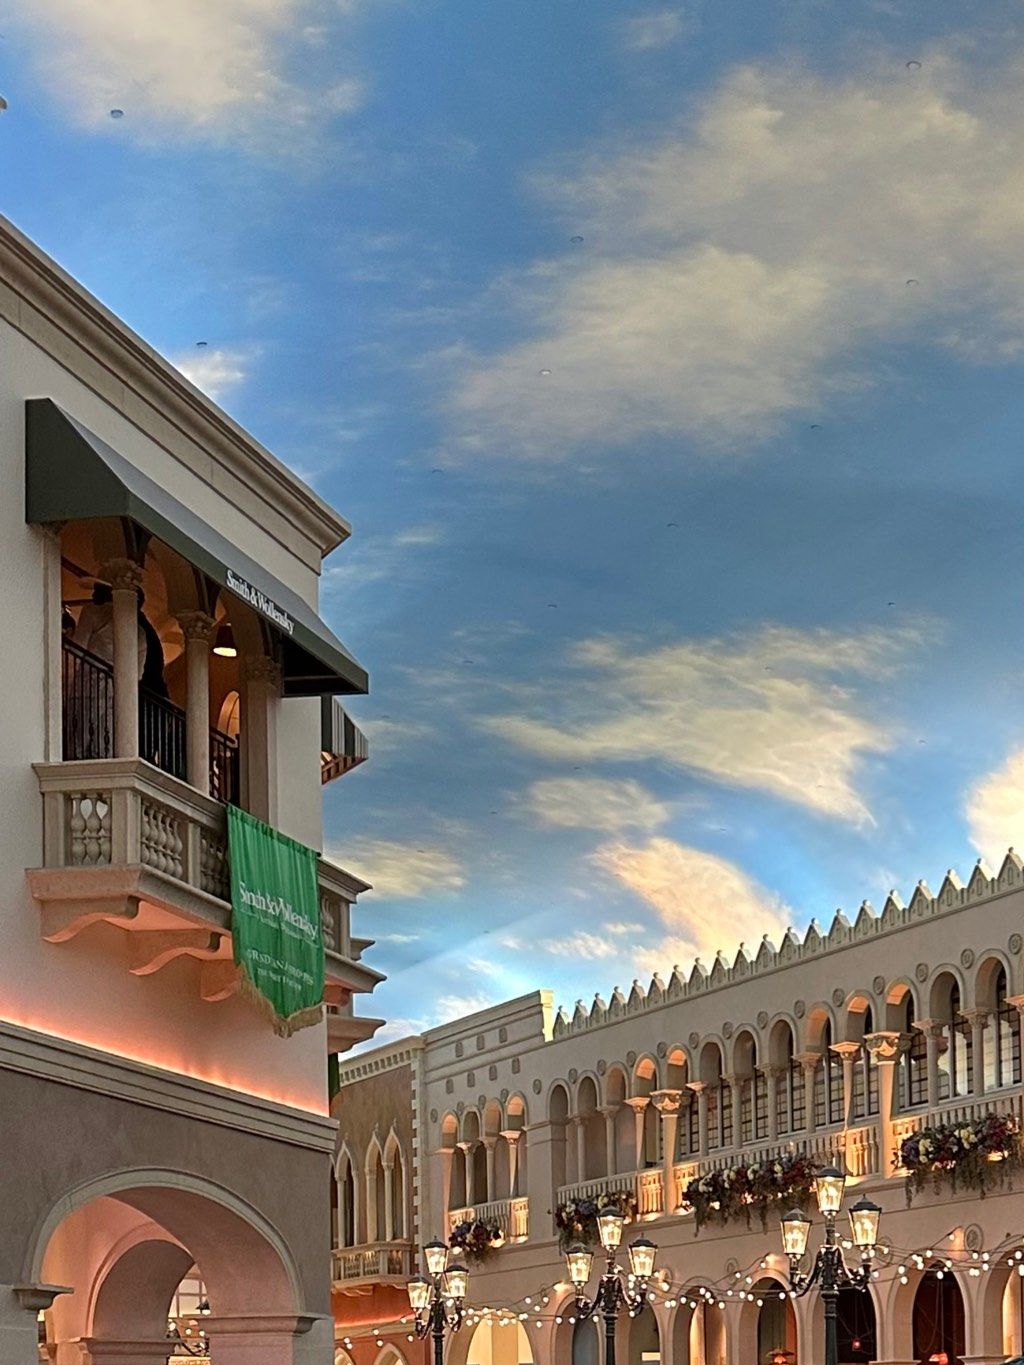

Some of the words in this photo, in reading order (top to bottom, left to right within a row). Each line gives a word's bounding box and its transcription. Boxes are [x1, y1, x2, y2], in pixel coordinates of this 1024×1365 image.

[226, 569, 250, 601] Smith
[250, 586, 258, 608] &
[257, 590, 295, 635] Wollensky
[272, 897, 319, 941] Wllensky
